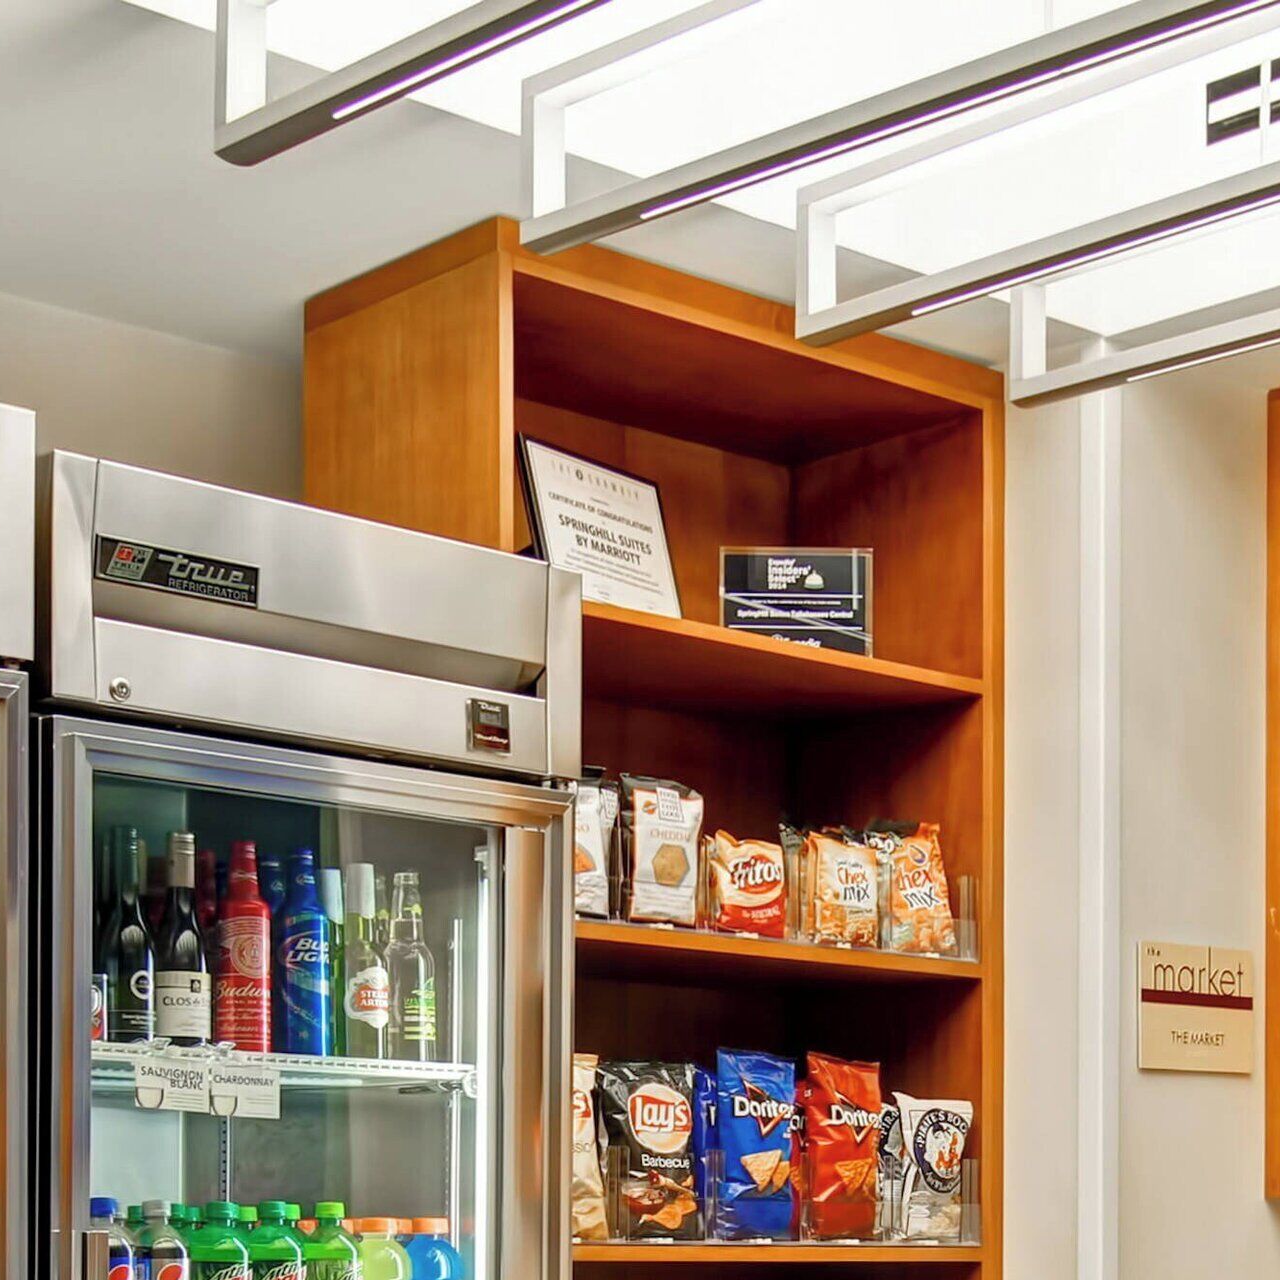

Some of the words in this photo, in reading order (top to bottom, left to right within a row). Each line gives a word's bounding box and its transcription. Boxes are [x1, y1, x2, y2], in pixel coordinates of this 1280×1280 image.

[558, 513, 618, 544] SPRINGHILL
[618, 535, 652, 556] SUITES
[575, 535, 588, 548] BY
[590, 538, 641, 566] MARRIOTT
[168, 577, 248, 601] REFRIGERATOR
[730, 857, 782, 890] Fritos
[837, 865, 869, 887] Chex
[1153, 946, 1244, 998] market
[162, 995, 192, 1007] CLOS
[1171, 1030, 1188, 1045] THE
[1190, 1033, 1225, 1047] MARKET
[140, 1065, 204, 1082] SAUVIGNON
[169, 1077, 204, 1091] BLANC
[212, 1074, 276, 1087] CHARDONNAY
[633, 1096, 689, 1135] Lay's
[640, 1152, 692, 1170] Barbecue
